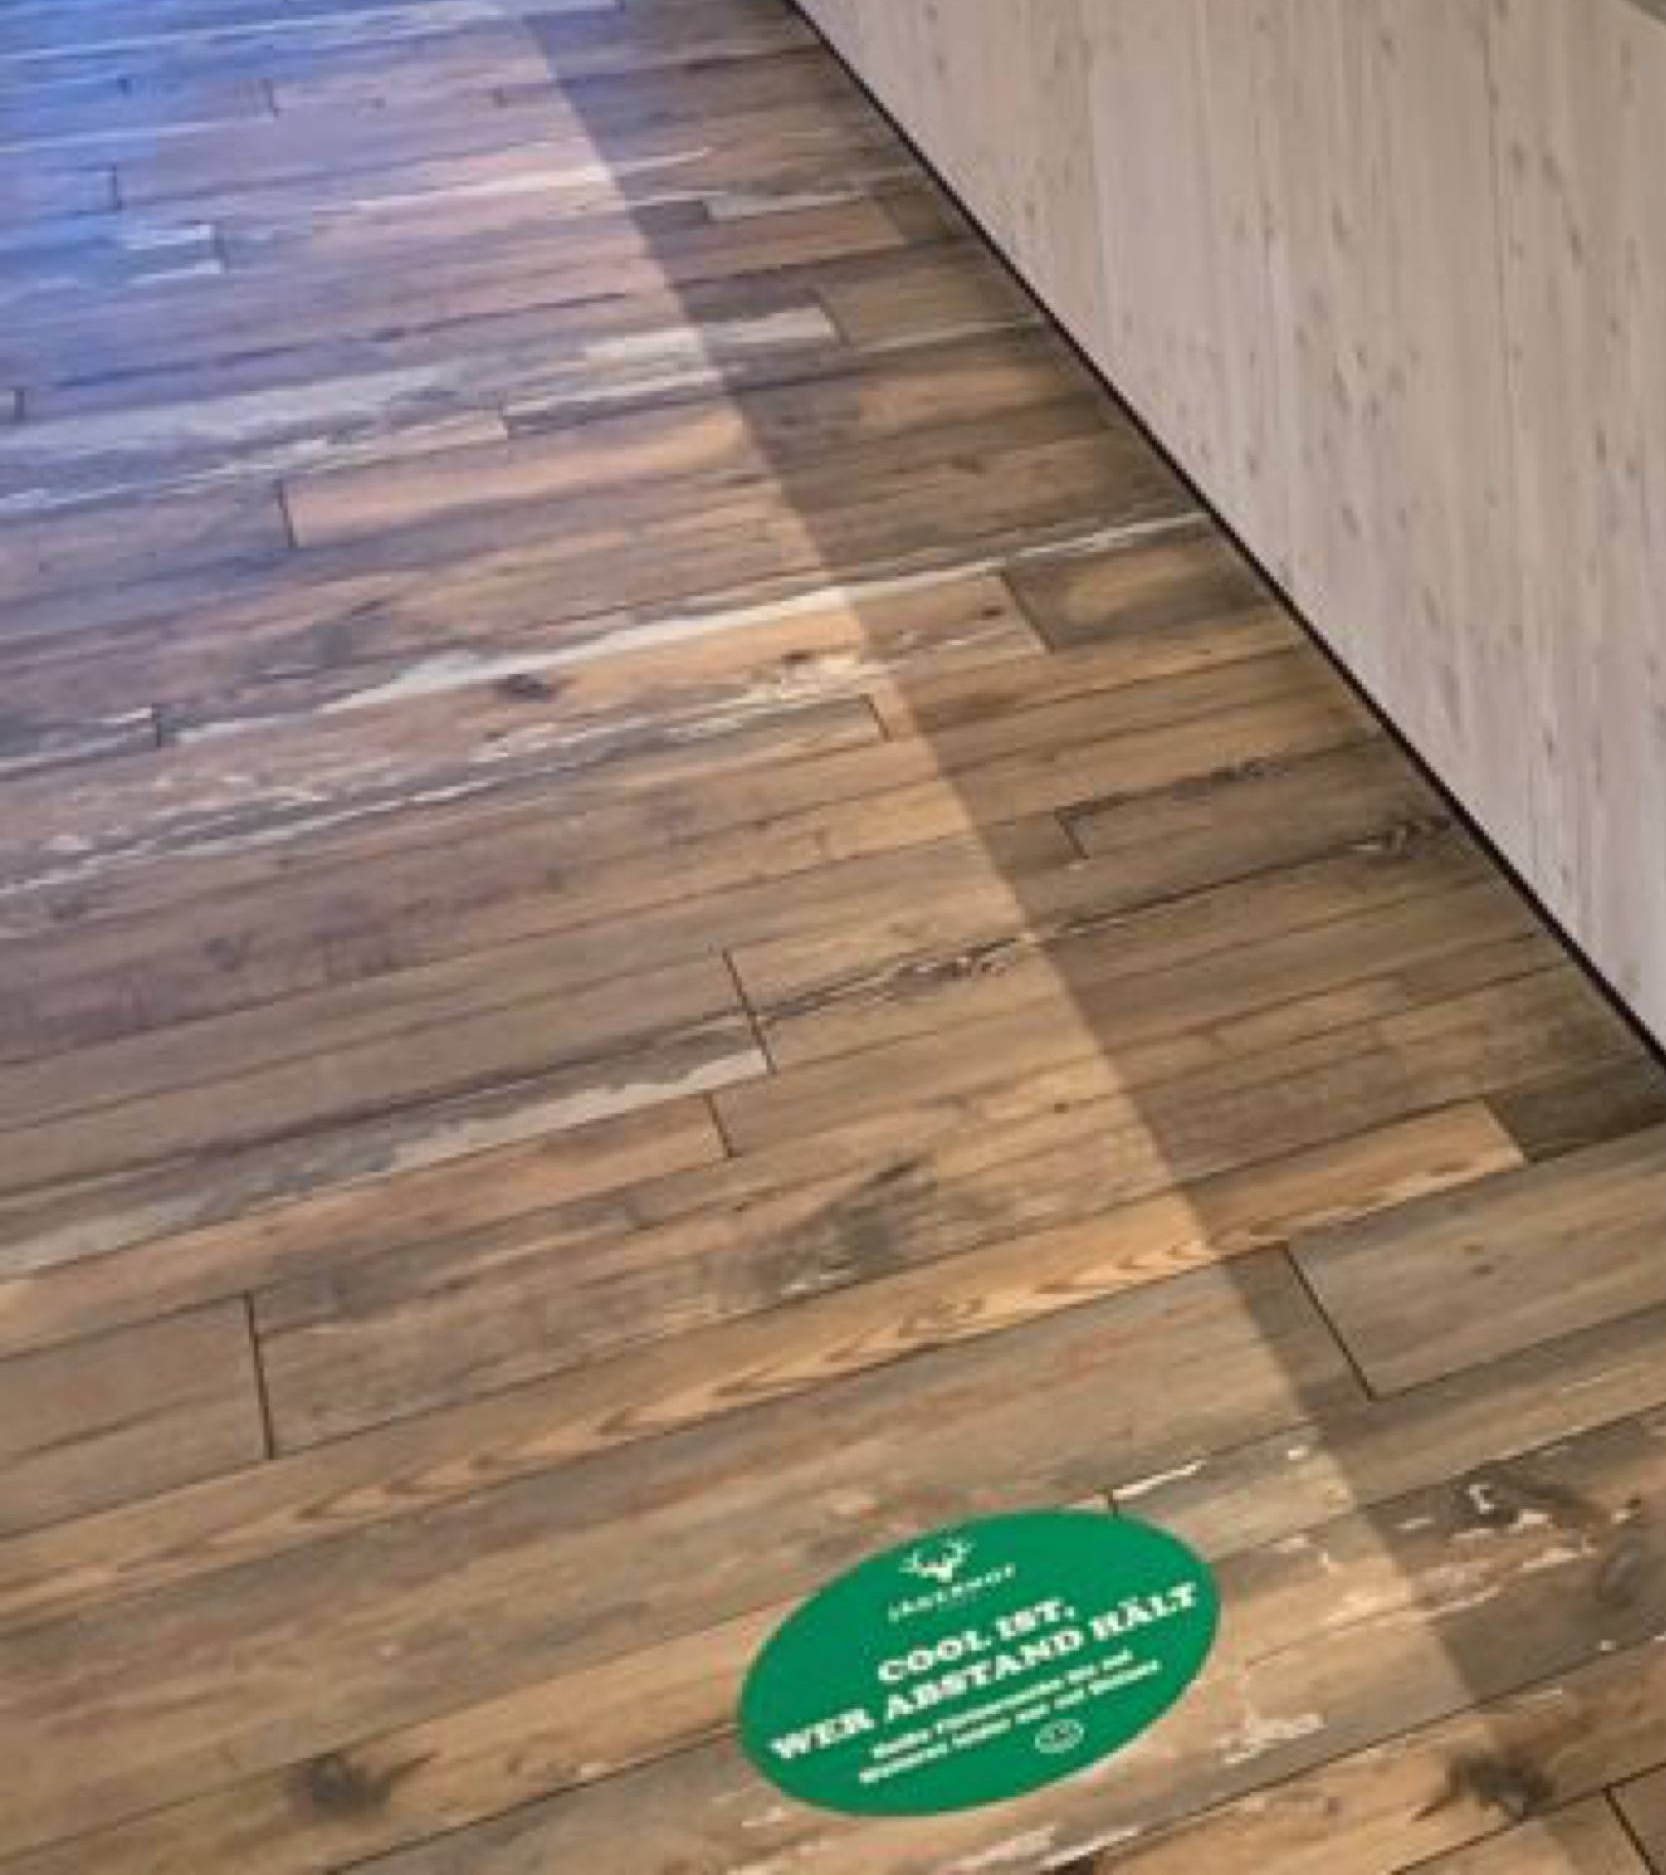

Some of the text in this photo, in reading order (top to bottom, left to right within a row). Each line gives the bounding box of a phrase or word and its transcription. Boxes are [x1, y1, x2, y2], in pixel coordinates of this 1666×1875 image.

[770, 1708, 876, 1759] WER
[884, 1628, 1084, 1720] ABSTAND
[1088, 1581, 1198, 1642] HÄLT
[878, 1630, 991, 1684] COOL
